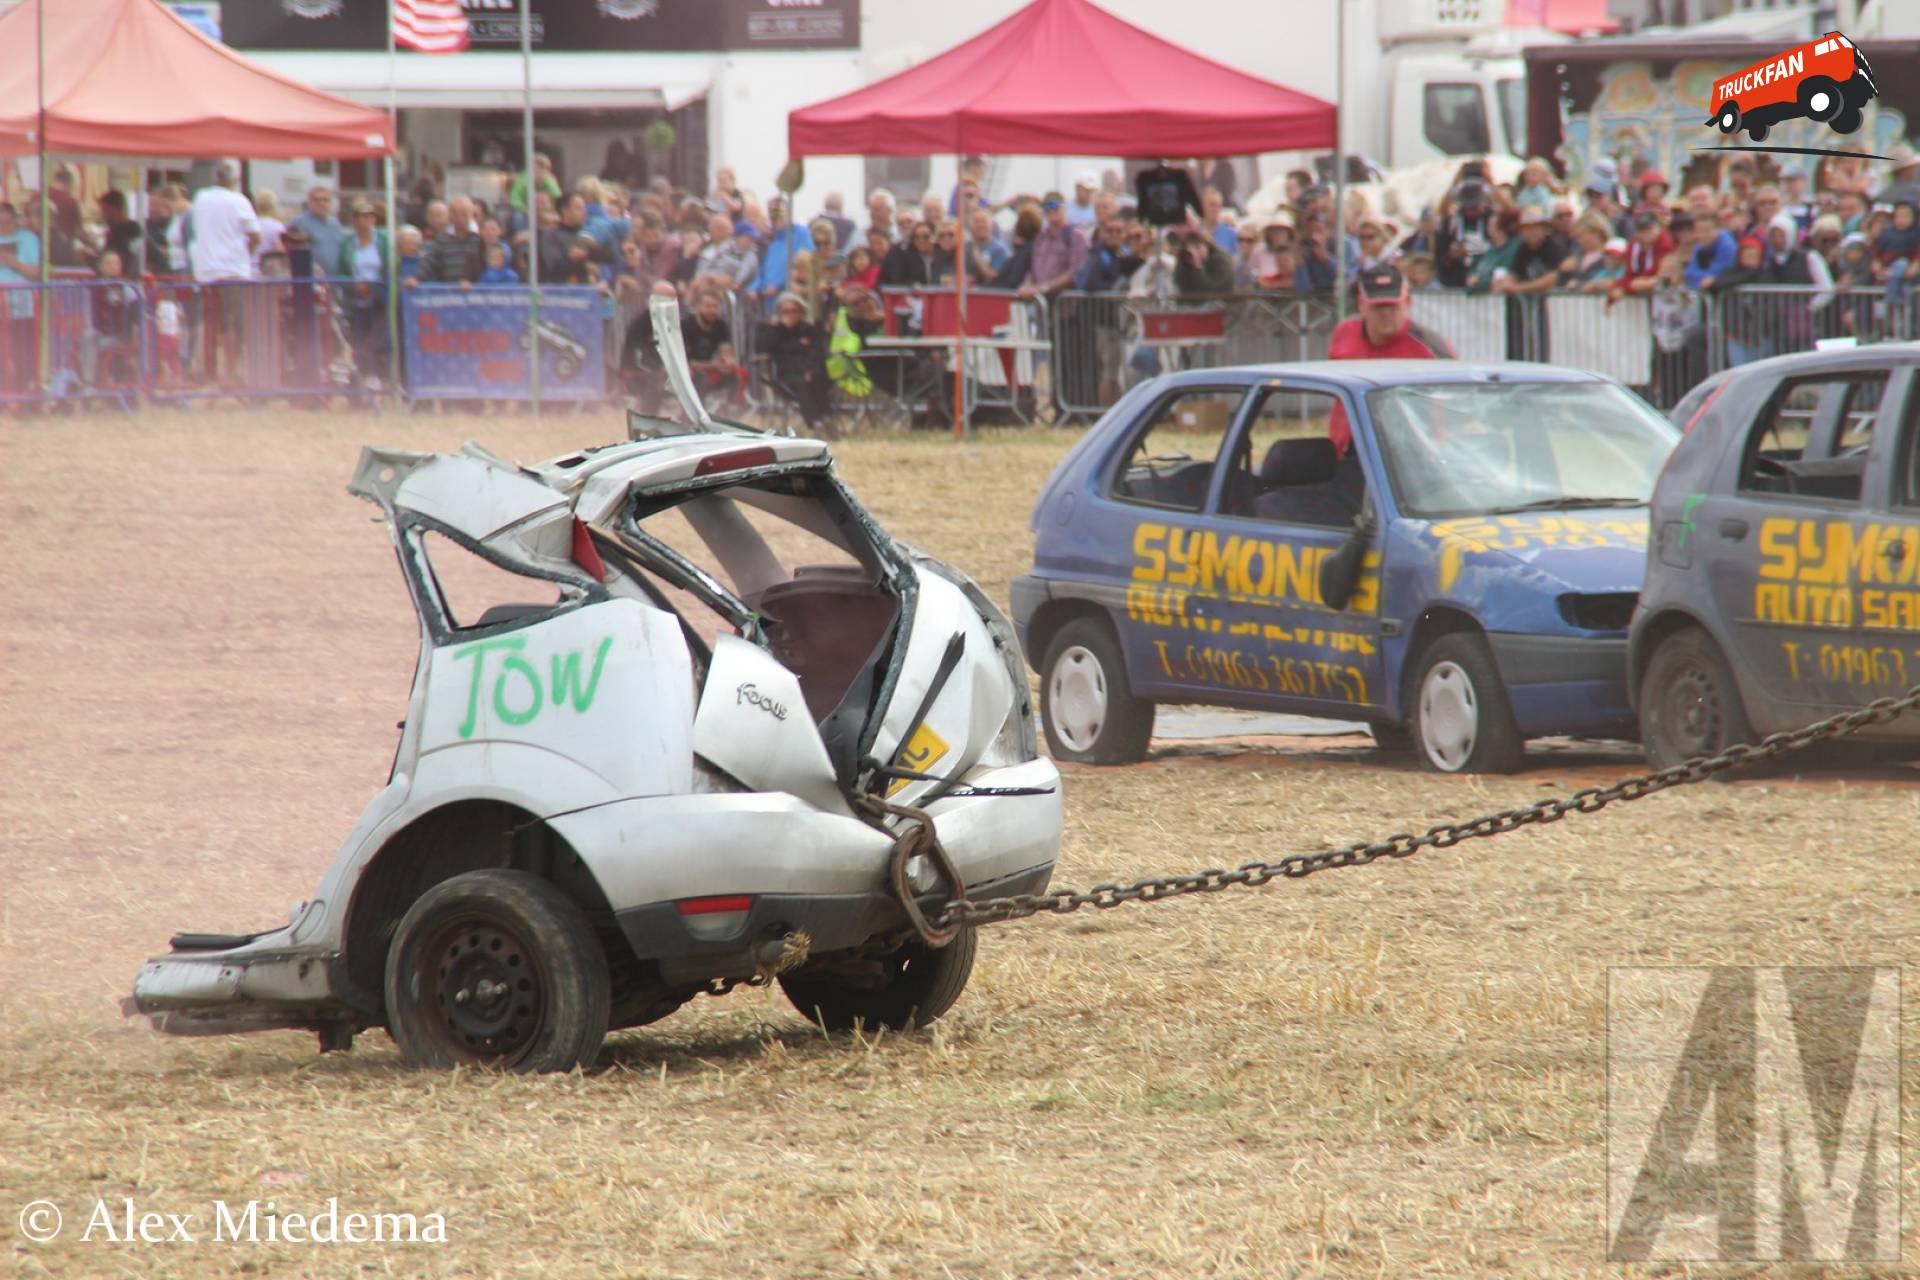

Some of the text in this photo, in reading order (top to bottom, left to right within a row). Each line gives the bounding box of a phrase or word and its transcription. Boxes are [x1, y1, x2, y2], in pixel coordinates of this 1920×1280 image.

[1758, 517, 1920, 584] SYMO
[1754, 583, 1920, 631] AUTO SA
[453, 636, 614, 738] TOW
[736, 681, 788, 721] Focus
